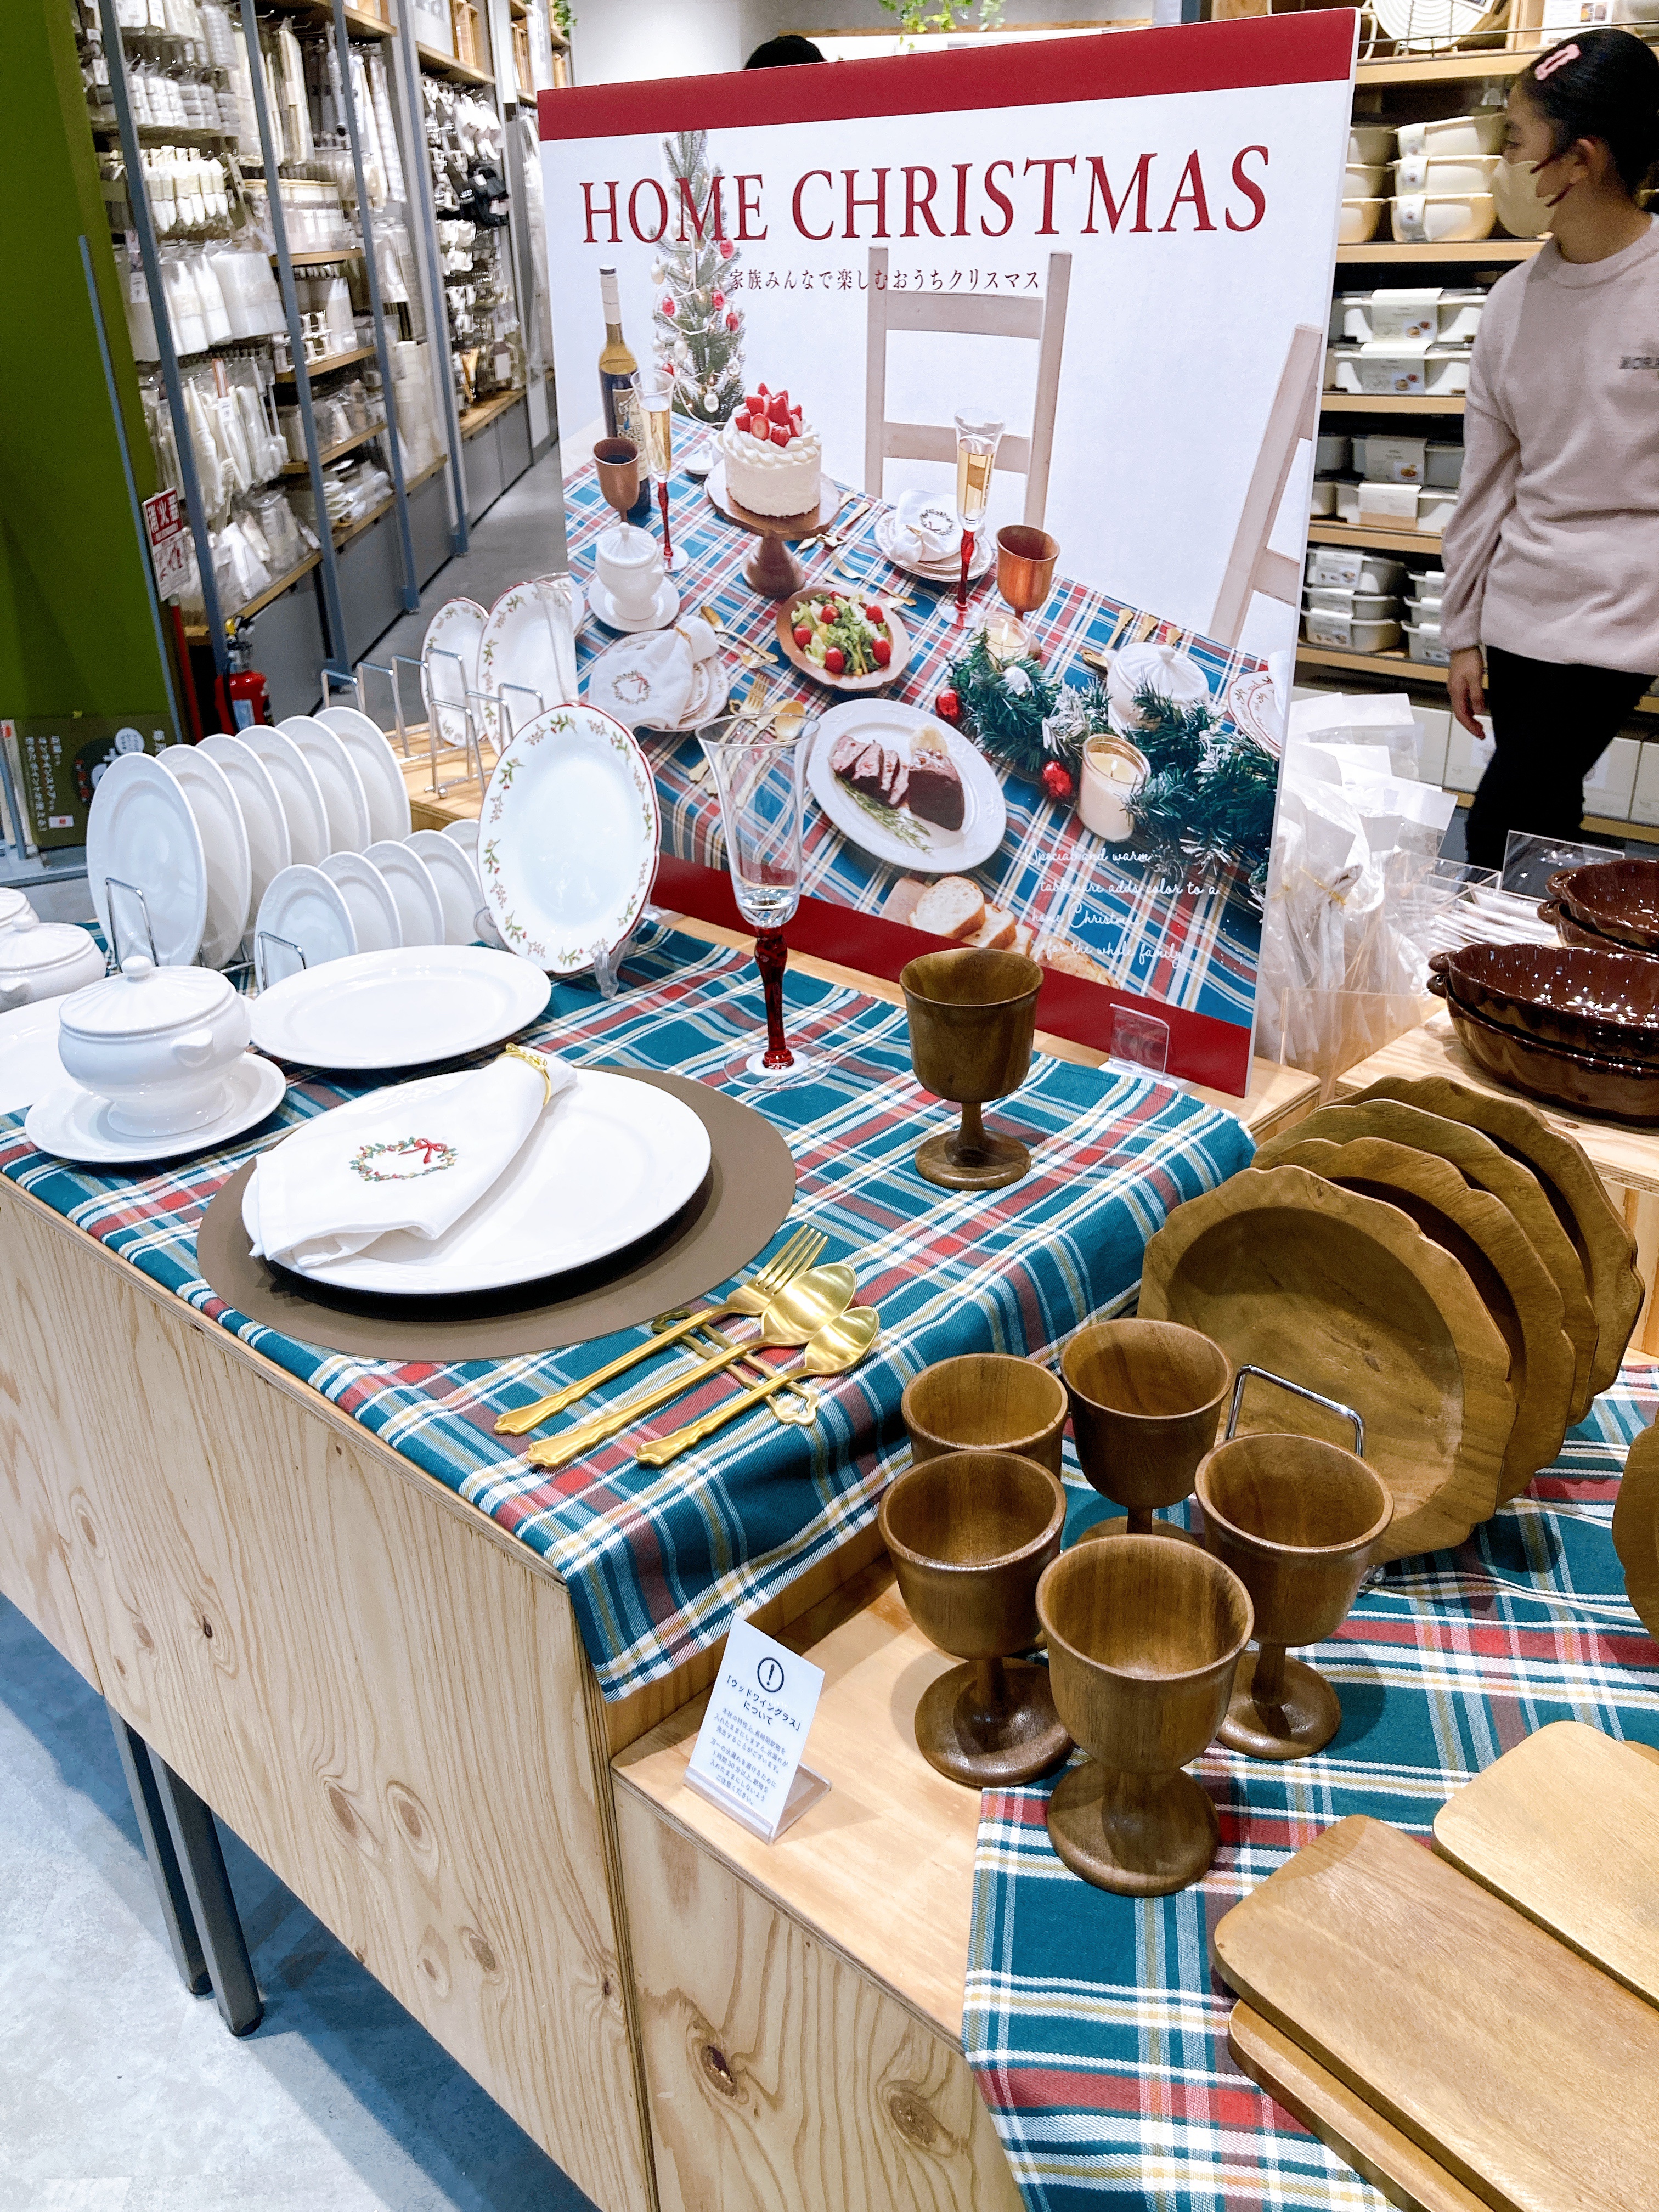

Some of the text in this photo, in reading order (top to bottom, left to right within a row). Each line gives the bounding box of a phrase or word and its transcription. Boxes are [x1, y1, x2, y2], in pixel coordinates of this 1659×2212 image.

[579, 145, 1269, 244] HOME CHRISTMAS
[729, 268, 1040, 291] 家族みんなで楽しむおうちクリスマス
[1024, 839, 1152, 866] Special and warm
[1108, 879, 1143, 894] adds
[1146, 878, 1183, 894] color
[1187, 881, 1205, 895] to
[1209, 885, 1220, 895] a
[1068, 901, 1143, 928] Christmas
[1046, 939, 1068, 960] for
[1071, 941, 1092, 955] the
[1096, 940, 1135, 957] whole
[726, 1674, 801, 1731] 「ウッドワイングラス」
[743, 1700, 773, 1725] について
